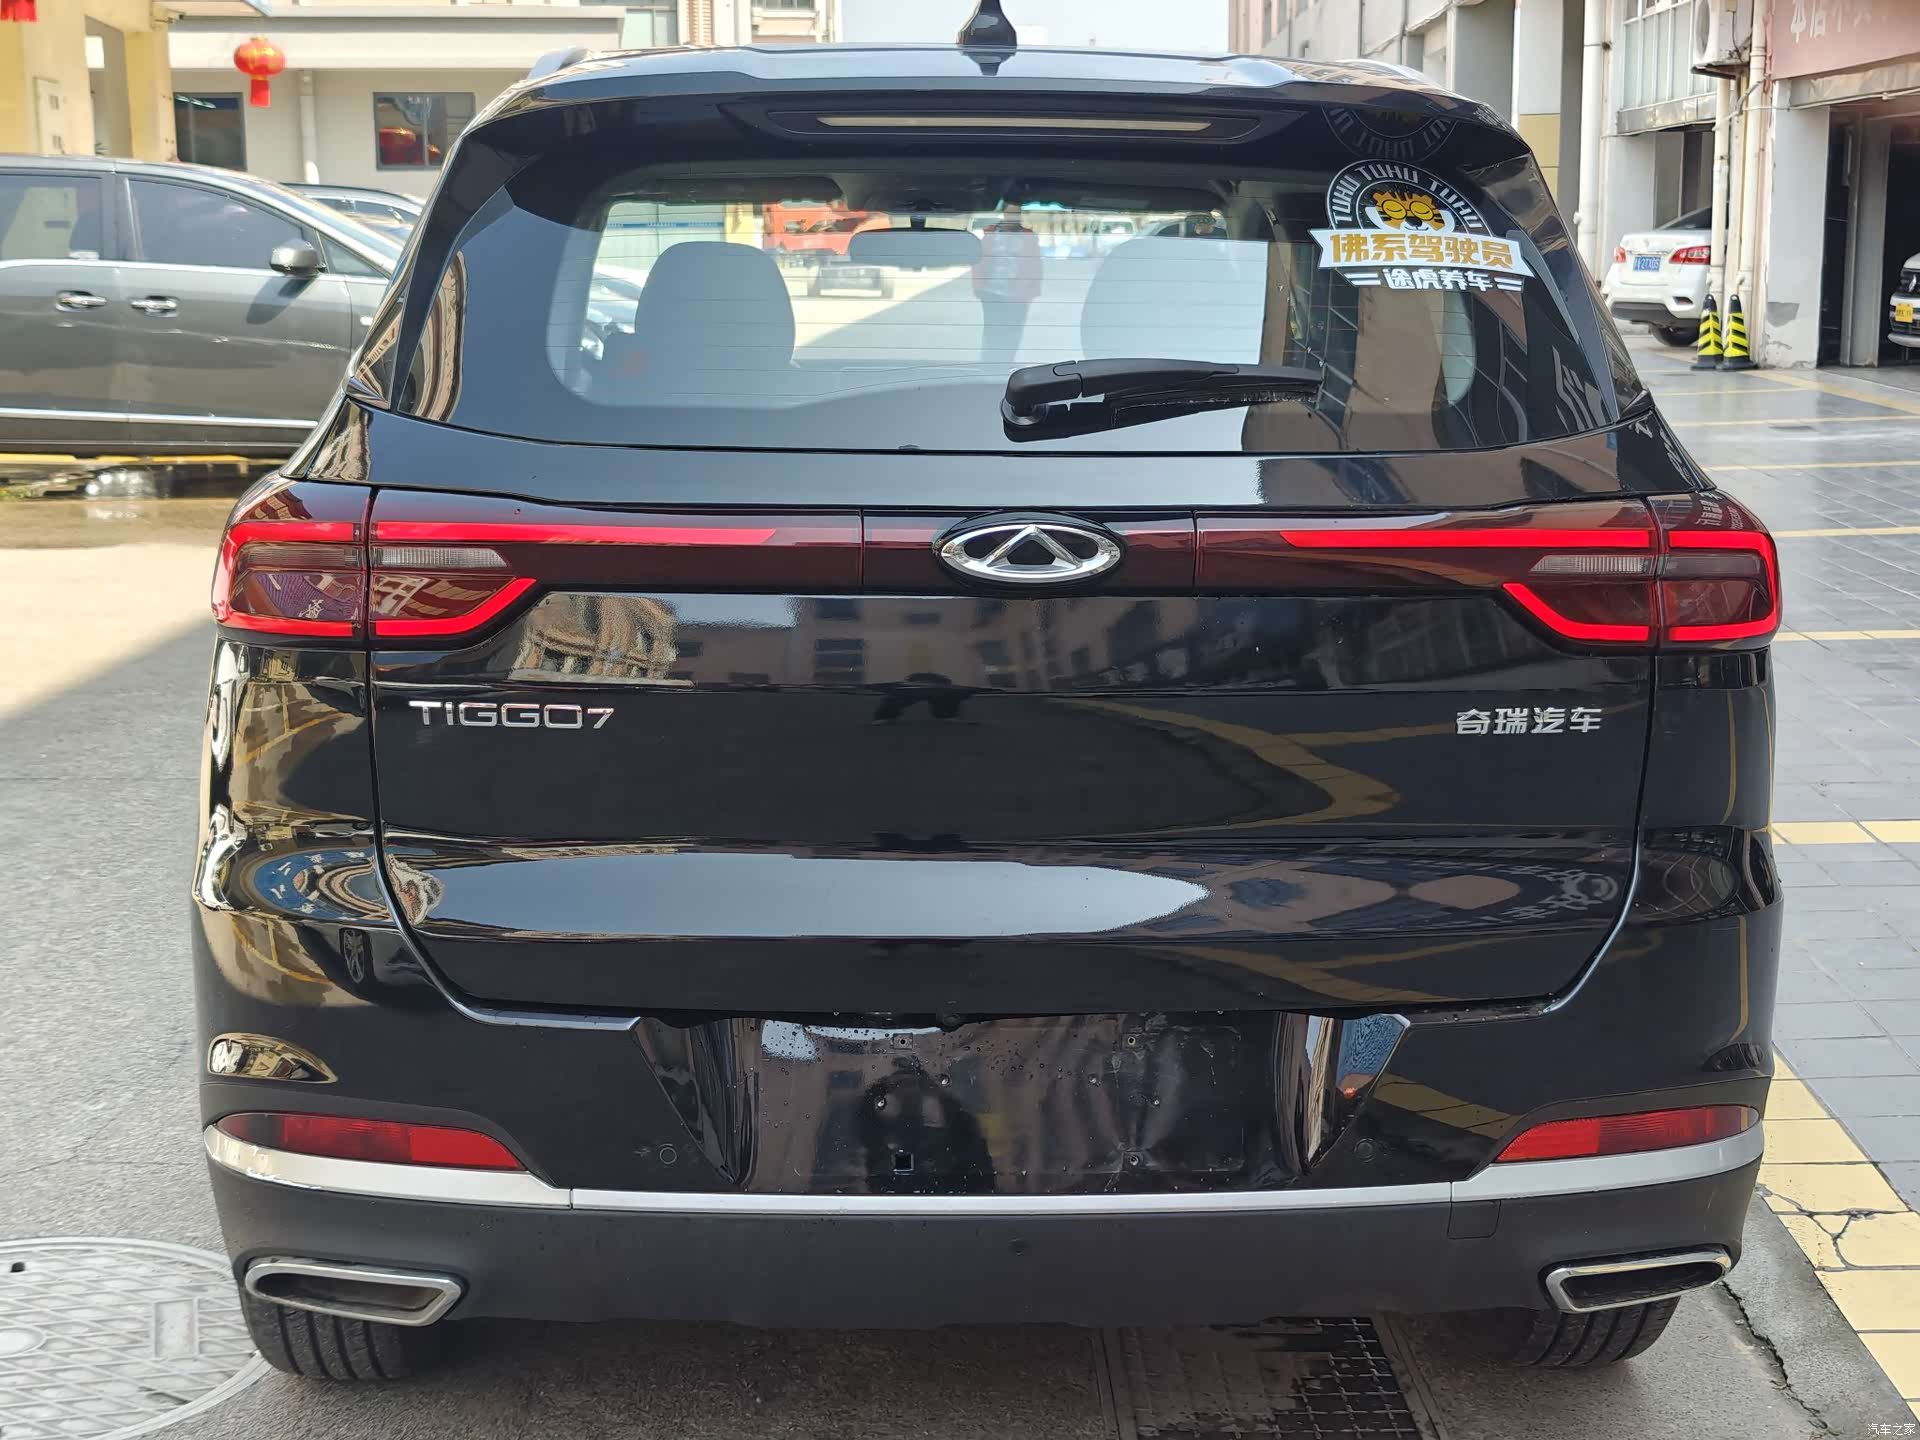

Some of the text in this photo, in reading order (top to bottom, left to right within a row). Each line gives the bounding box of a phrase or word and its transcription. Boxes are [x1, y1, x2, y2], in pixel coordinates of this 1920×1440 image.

[1331, 163, 1484, 229] TUHU TUHU TUHU
[1329, 232, 1514, 269] 佛系驾驶员
[1382, 268, 1494, 292] 途虎养车
[1456, 707, 1603, 735] 奇瑞汽车
